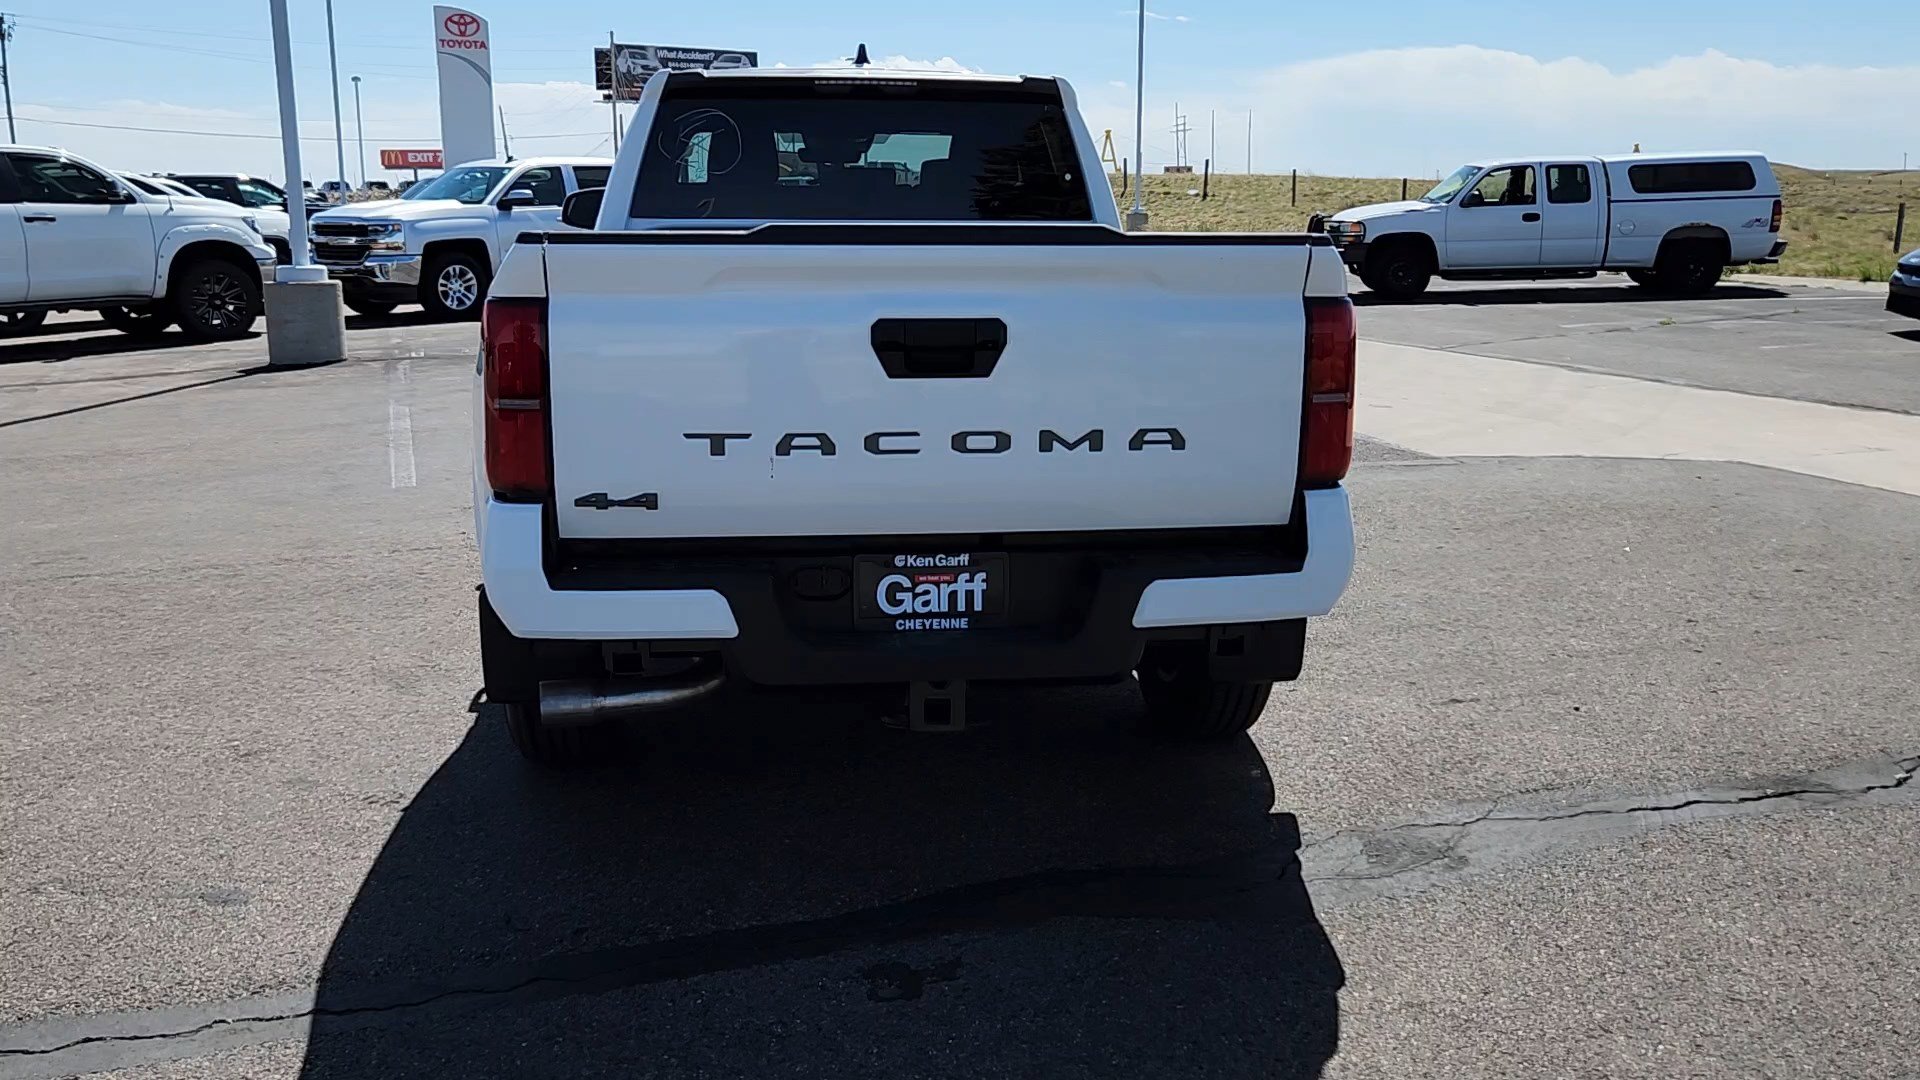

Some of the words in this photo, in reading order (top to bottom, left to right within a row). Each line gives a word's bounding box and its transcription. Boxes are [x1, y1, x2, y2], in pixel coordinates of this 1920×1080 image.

[439, 38, 488, 50] TOYOTA
[656, 49, 677, 59] What
[677, 51, 716, 61] Accident?
[407, 152, 434, 163] EXIT
[682, 427, 1187, 457] TACOMA
[906, 554, 934, 567] Ken
[935, 553, 970, 567] Garff
[876, 572, 988, 615] Garff
[895, 617, 969, 630] CHEYENNE
